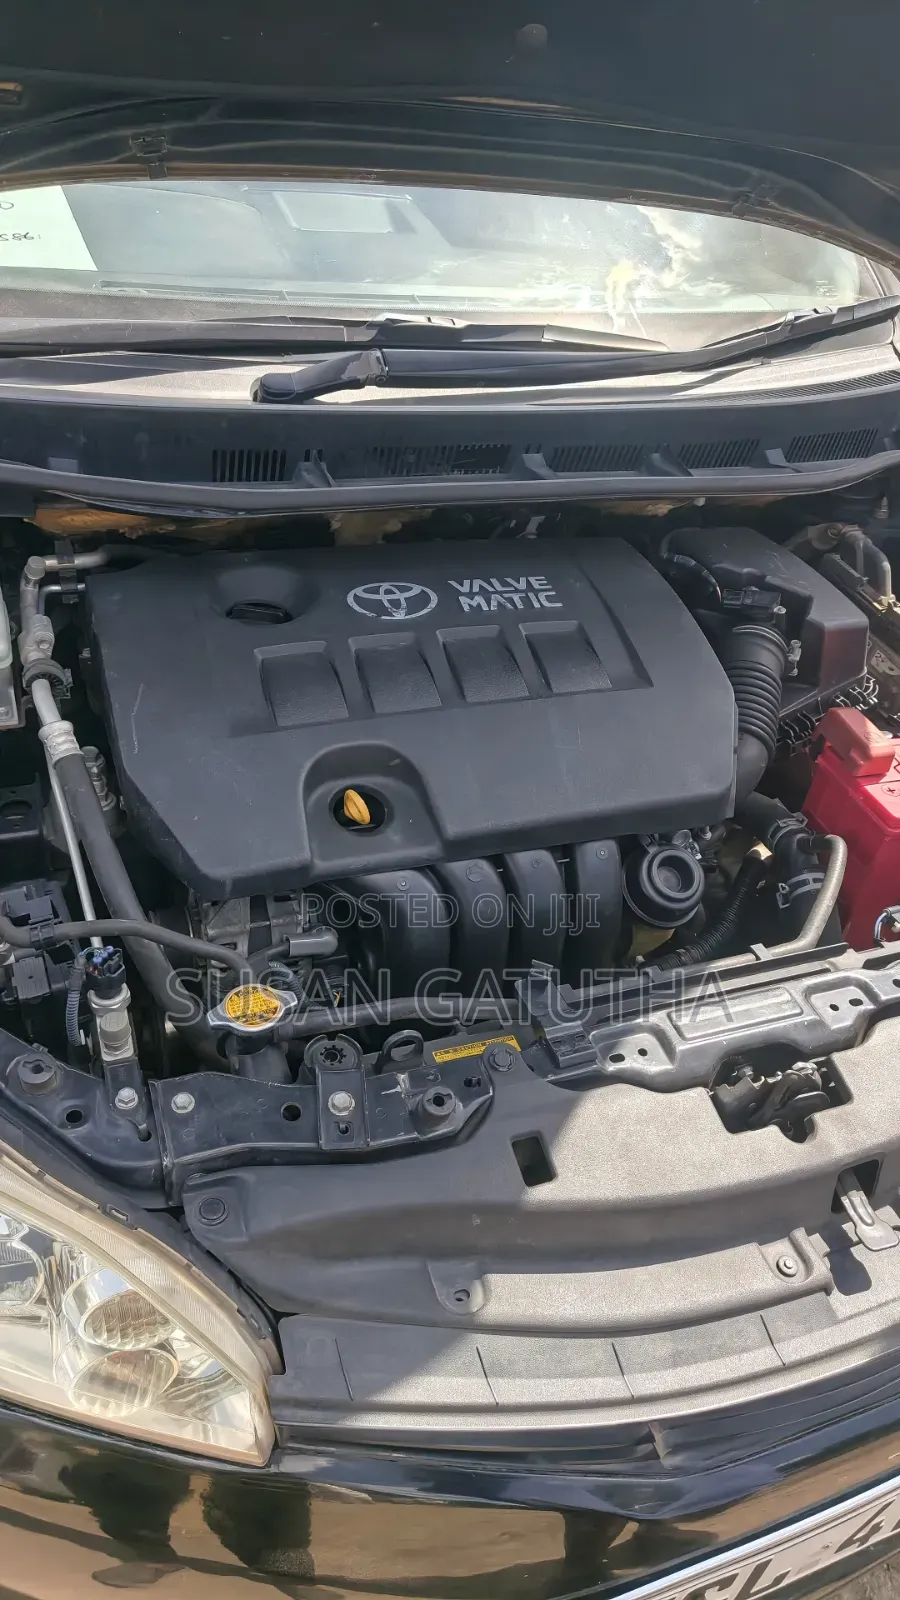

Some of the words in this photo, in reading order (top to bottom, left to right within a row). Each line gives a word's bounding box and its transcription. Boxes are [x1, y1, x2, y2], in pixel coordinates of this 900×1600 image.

[447, 576, 552, 593] VALVE
[458, 591, 563, 612] MATIC
[833, 1498, 900, 1555] 4
